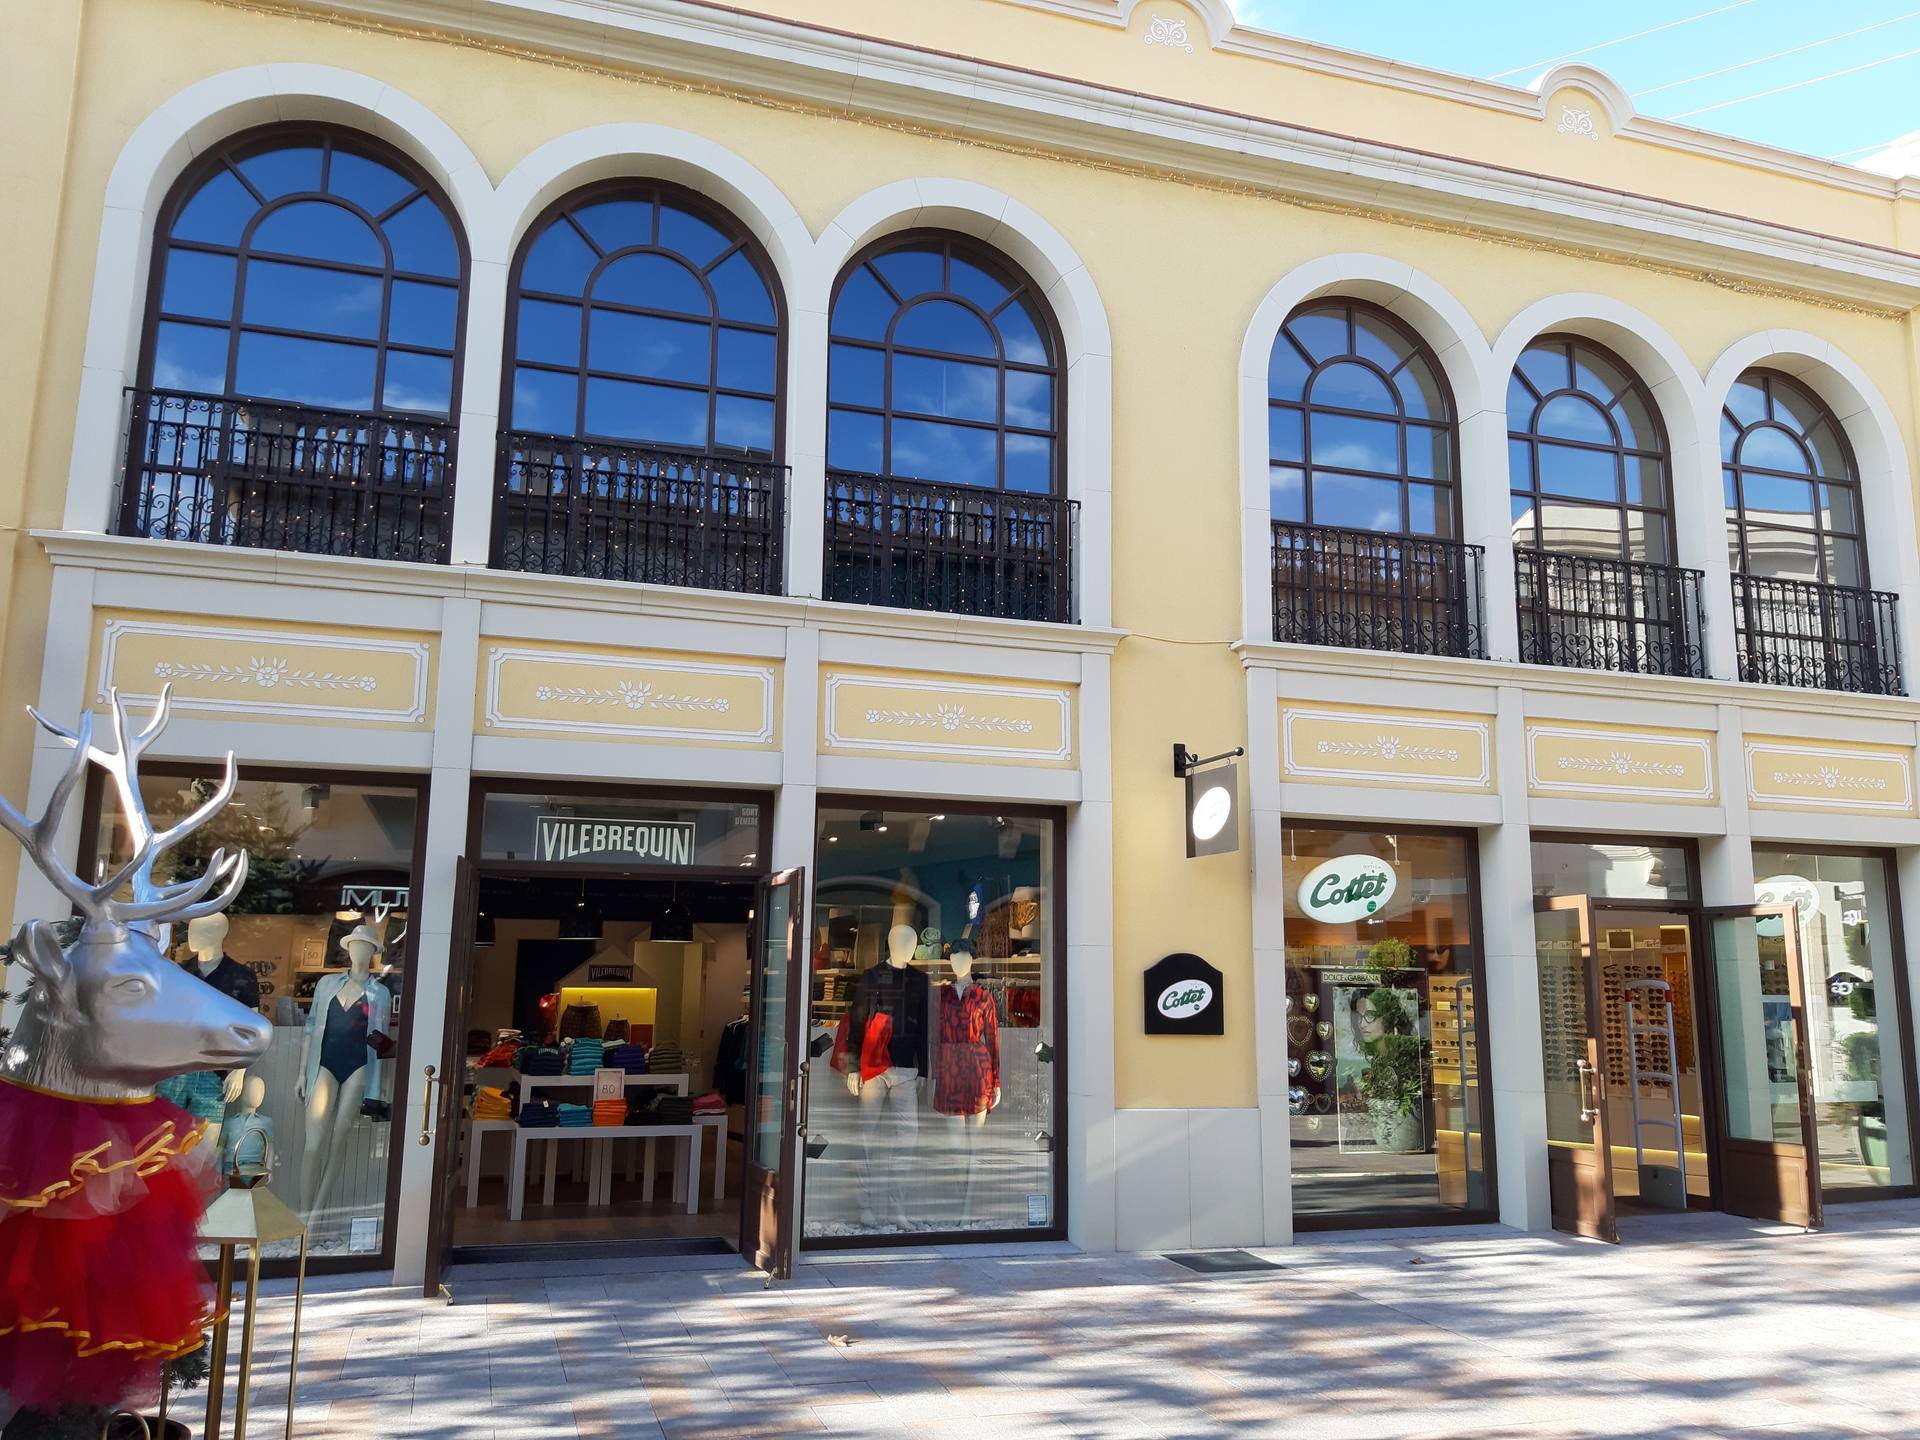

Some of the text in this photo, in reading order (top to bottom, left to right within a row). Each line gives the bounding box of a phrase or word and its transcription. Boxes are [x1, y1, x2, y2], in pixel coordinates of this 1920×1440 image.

[543, 822, 690, 865] VILEBREQUIN
[1310, 872, 1388, 908] Cottet
[1162, 988, 1206, 1011] Cottet
[602, 1083, 615, 1094] 80
